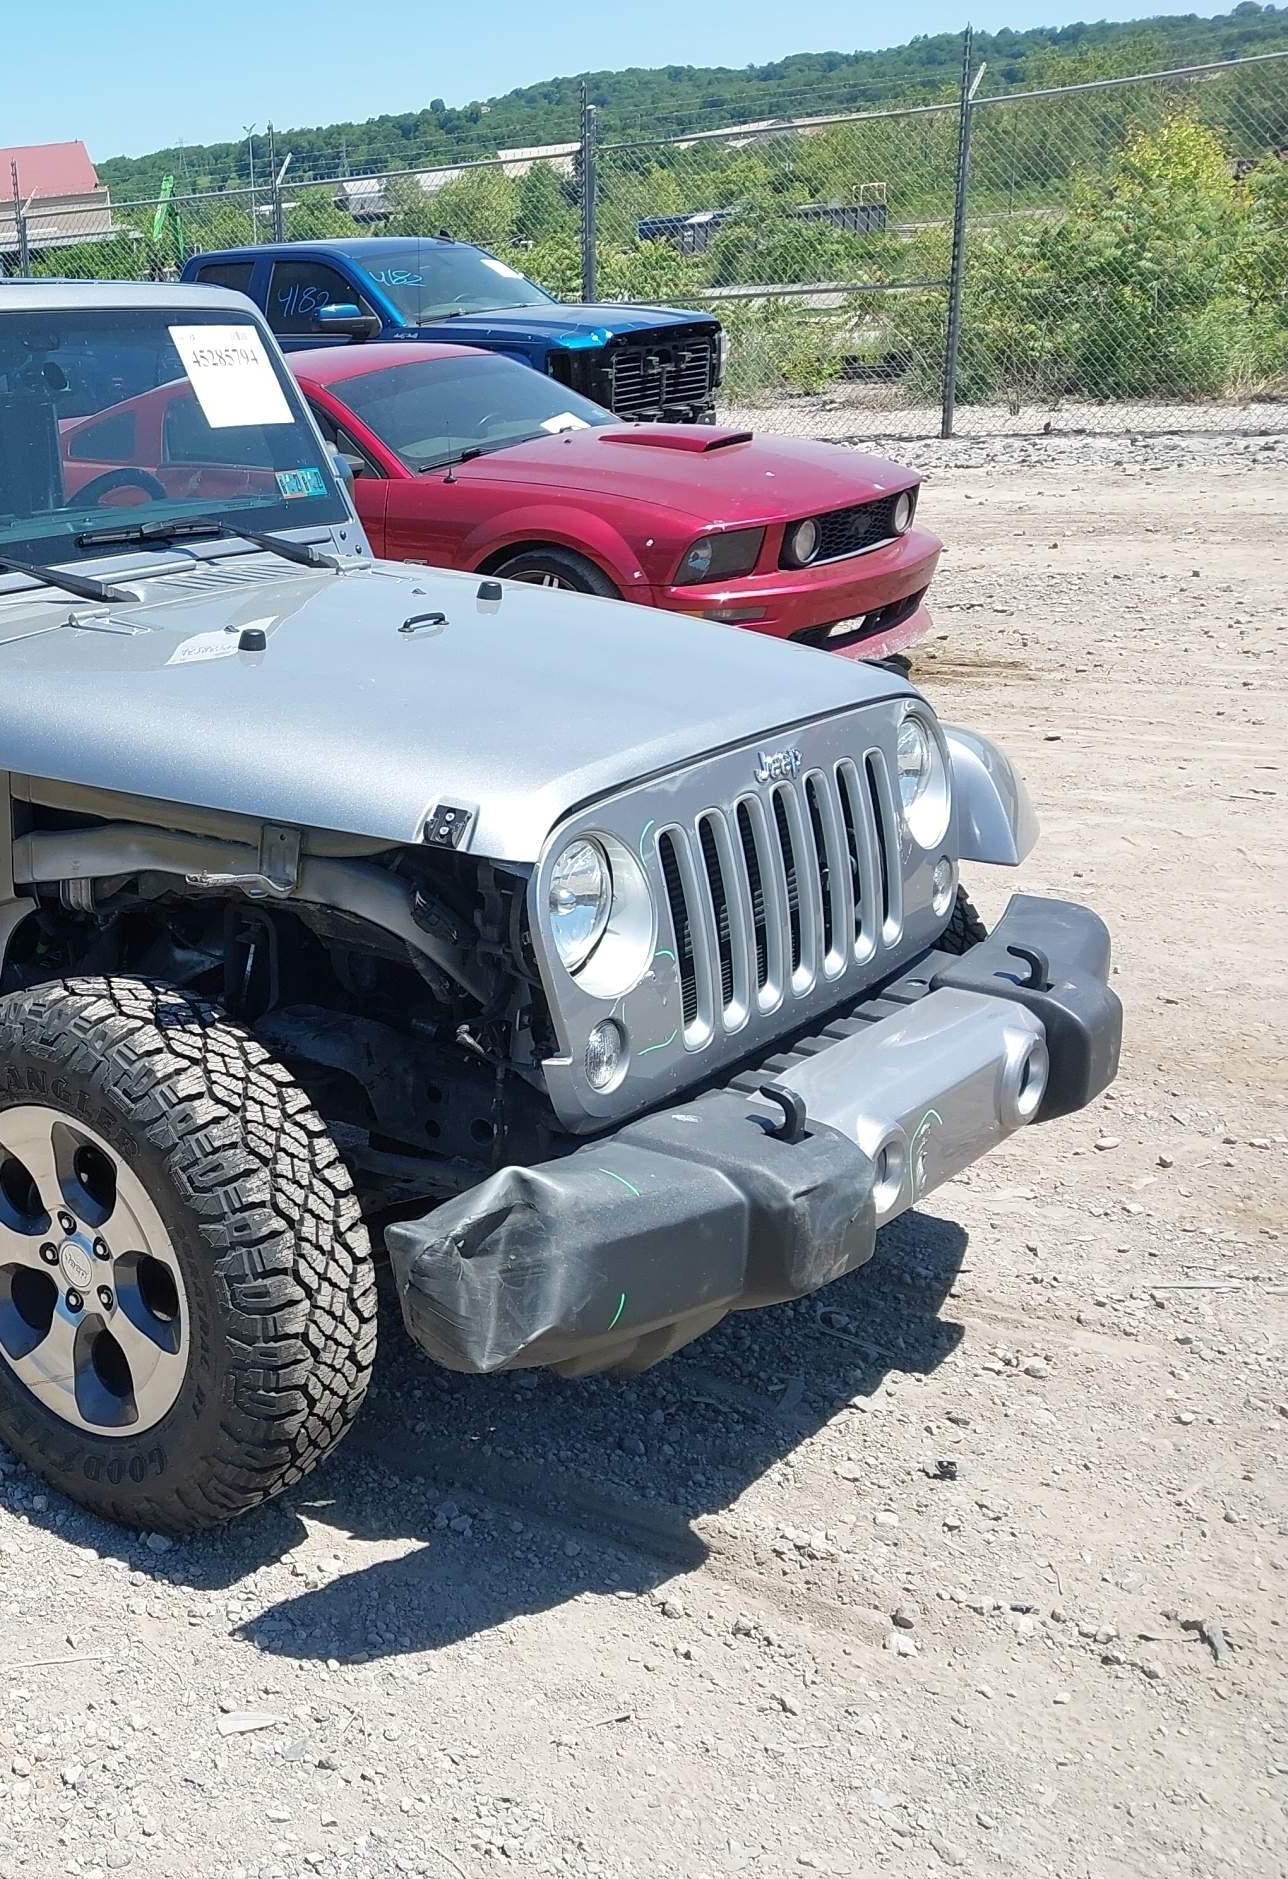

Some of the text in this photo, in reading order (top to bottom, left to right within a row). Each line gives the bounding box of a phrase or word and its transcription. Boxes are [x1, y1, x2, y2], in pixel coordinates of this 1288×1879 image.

[369, 268, 427, 288] 4182
[278, 283, 330, 318] 4182
[192, 347, 259, 368] 45285794
[753, 748, 803, 784] Jeep
